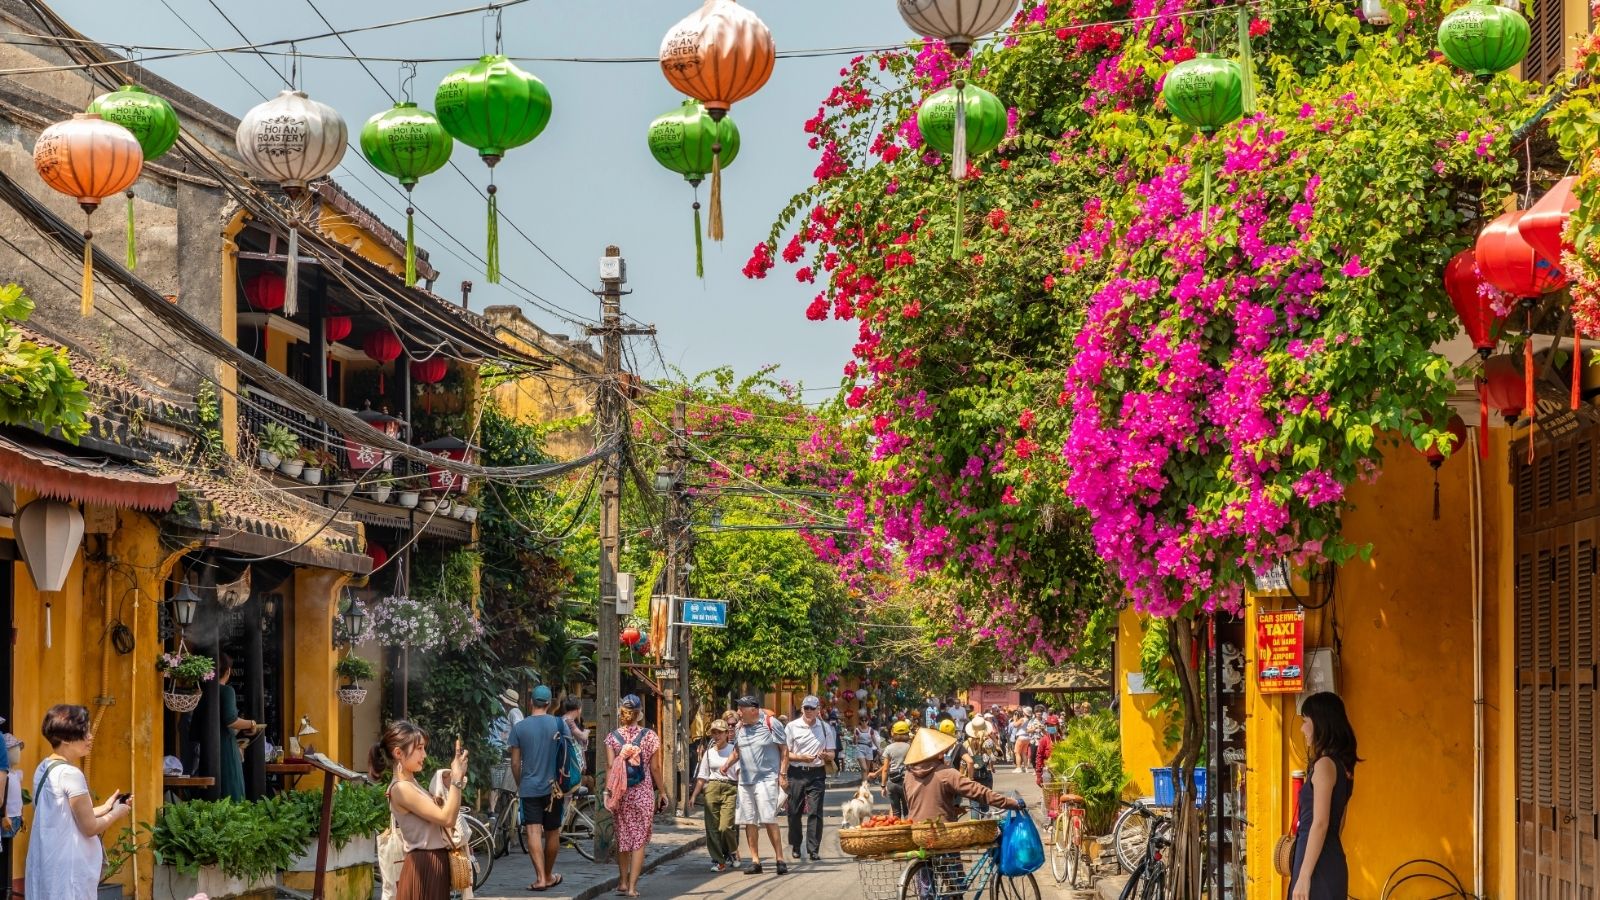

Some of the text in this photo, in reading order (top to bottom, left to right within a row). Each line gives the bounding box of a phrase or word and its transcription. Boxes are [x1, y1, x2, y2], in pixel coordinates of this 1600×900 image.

[1448, 21, 1484, 30] ROASTERY
[680, 38, 693, 46] AN
[1176, 81, 1213, 91] ROASTERY
[133, 106, 146, 115] AN
[930, 111, 961, 119] ROASTE
[110, 113, 153, 122] ROASTERY
[264, 125, 298, 134] HOI AN
[393, 126, 422, 135] HOI AN
[664, 126, 676, 134] AN
[257, 132, 306, 142] ROASTERY
[388, 131, 429, 142] ROASTERY
[1259, 613, 1303, 623] CAR SERVICE
[1265, 622, 1295, 636] TAXI
